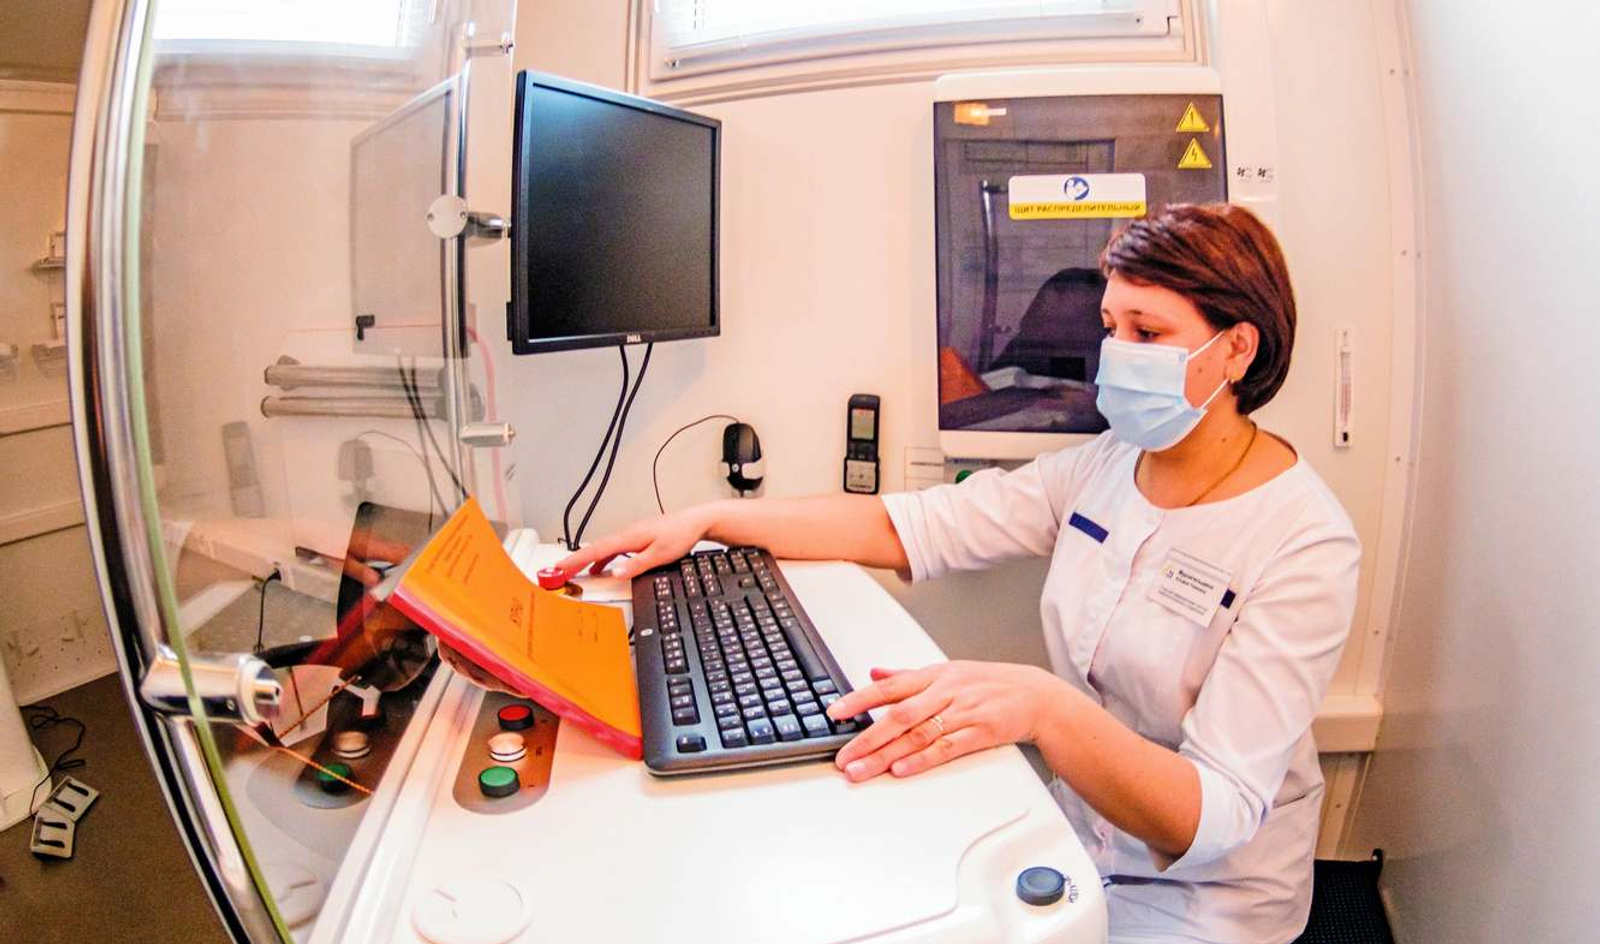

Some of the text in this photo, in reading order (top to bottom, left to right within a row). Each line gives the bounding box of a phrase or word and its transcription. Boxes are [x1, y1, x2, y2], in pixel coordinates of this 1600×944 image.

[1014, 203, 1141, 214] ЩИТ РАСПРЕДЕЛИТЕЛЬНЫЙ
[626, 333, 641, 343] DELL
